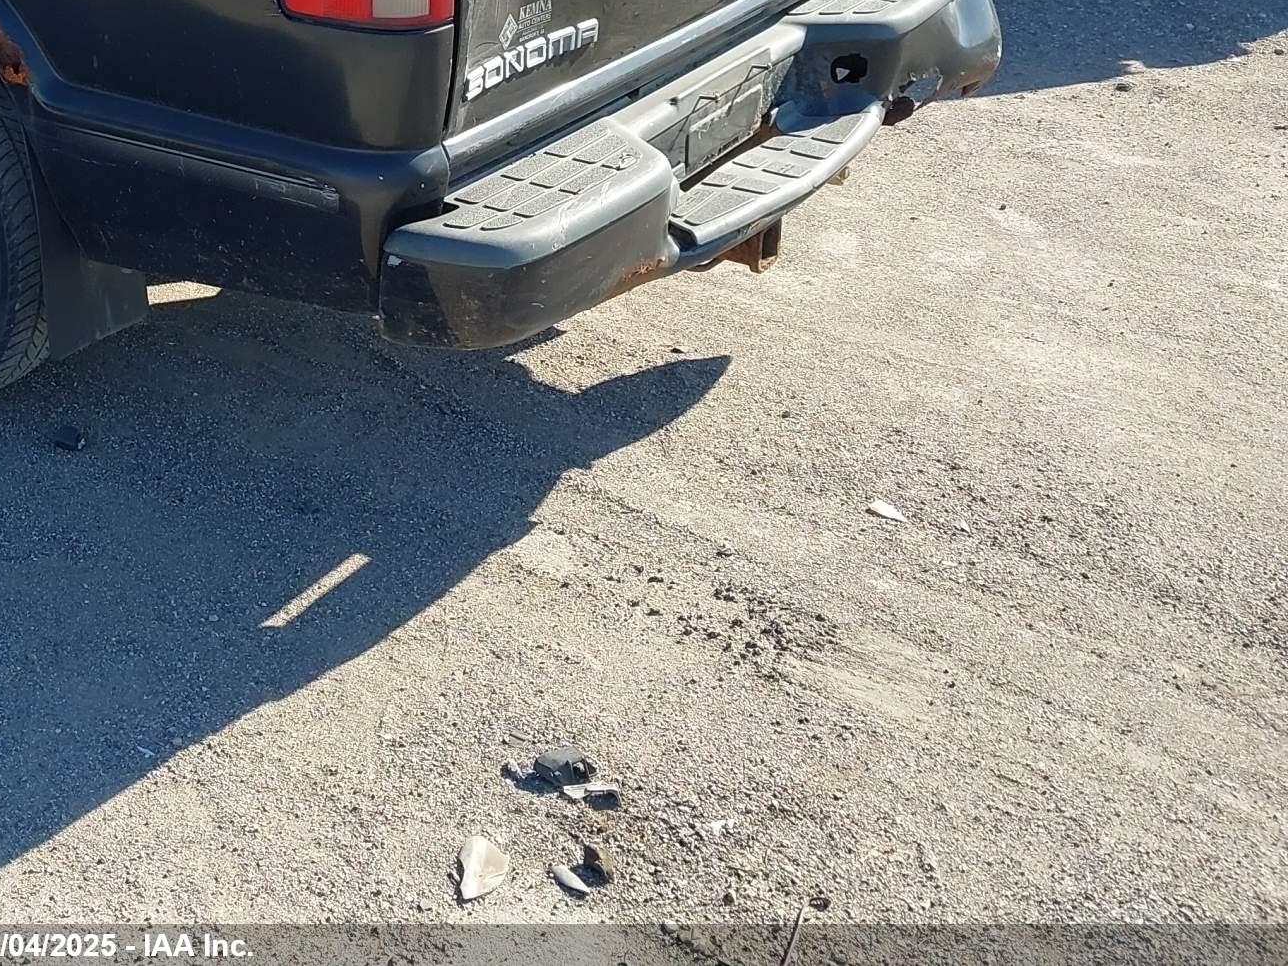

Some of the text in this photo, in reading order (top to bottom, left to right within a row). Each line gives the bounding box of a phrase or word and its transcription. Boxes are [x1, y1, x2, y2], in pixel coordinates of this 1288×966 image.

[518, 20, 531, 30] AUTO
[531, 12, 552, 25] CENTERS
[466, 18, 599, 101] SONOMA
